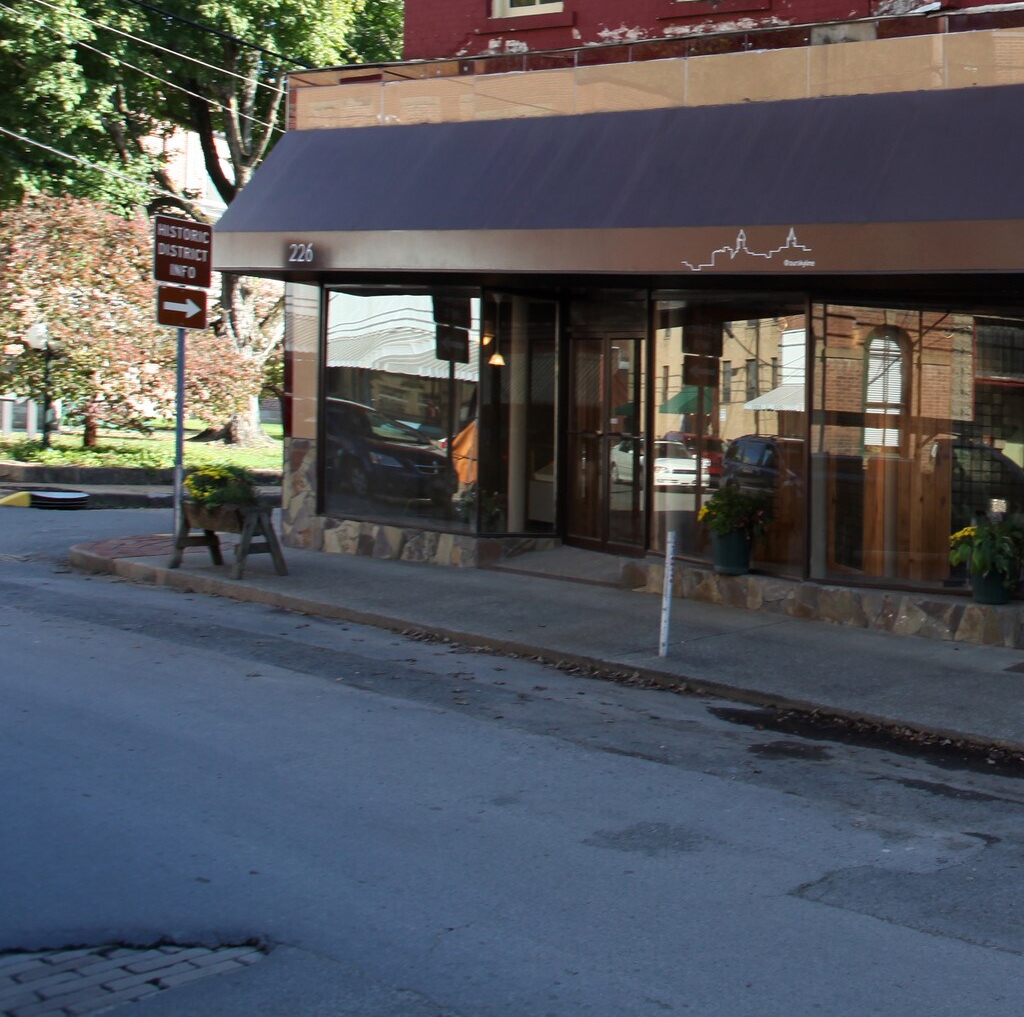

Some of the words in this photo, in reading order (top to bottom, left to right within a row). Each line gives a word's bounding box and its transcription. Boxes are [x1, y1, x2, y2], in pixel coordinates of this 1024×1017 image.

[157, 223, 210, 244] HISTORIC
[157, 242, 209, 262] DISTRICT
[288, 242, 314, 262] 226
[169, 263, 197, 279] INFO
